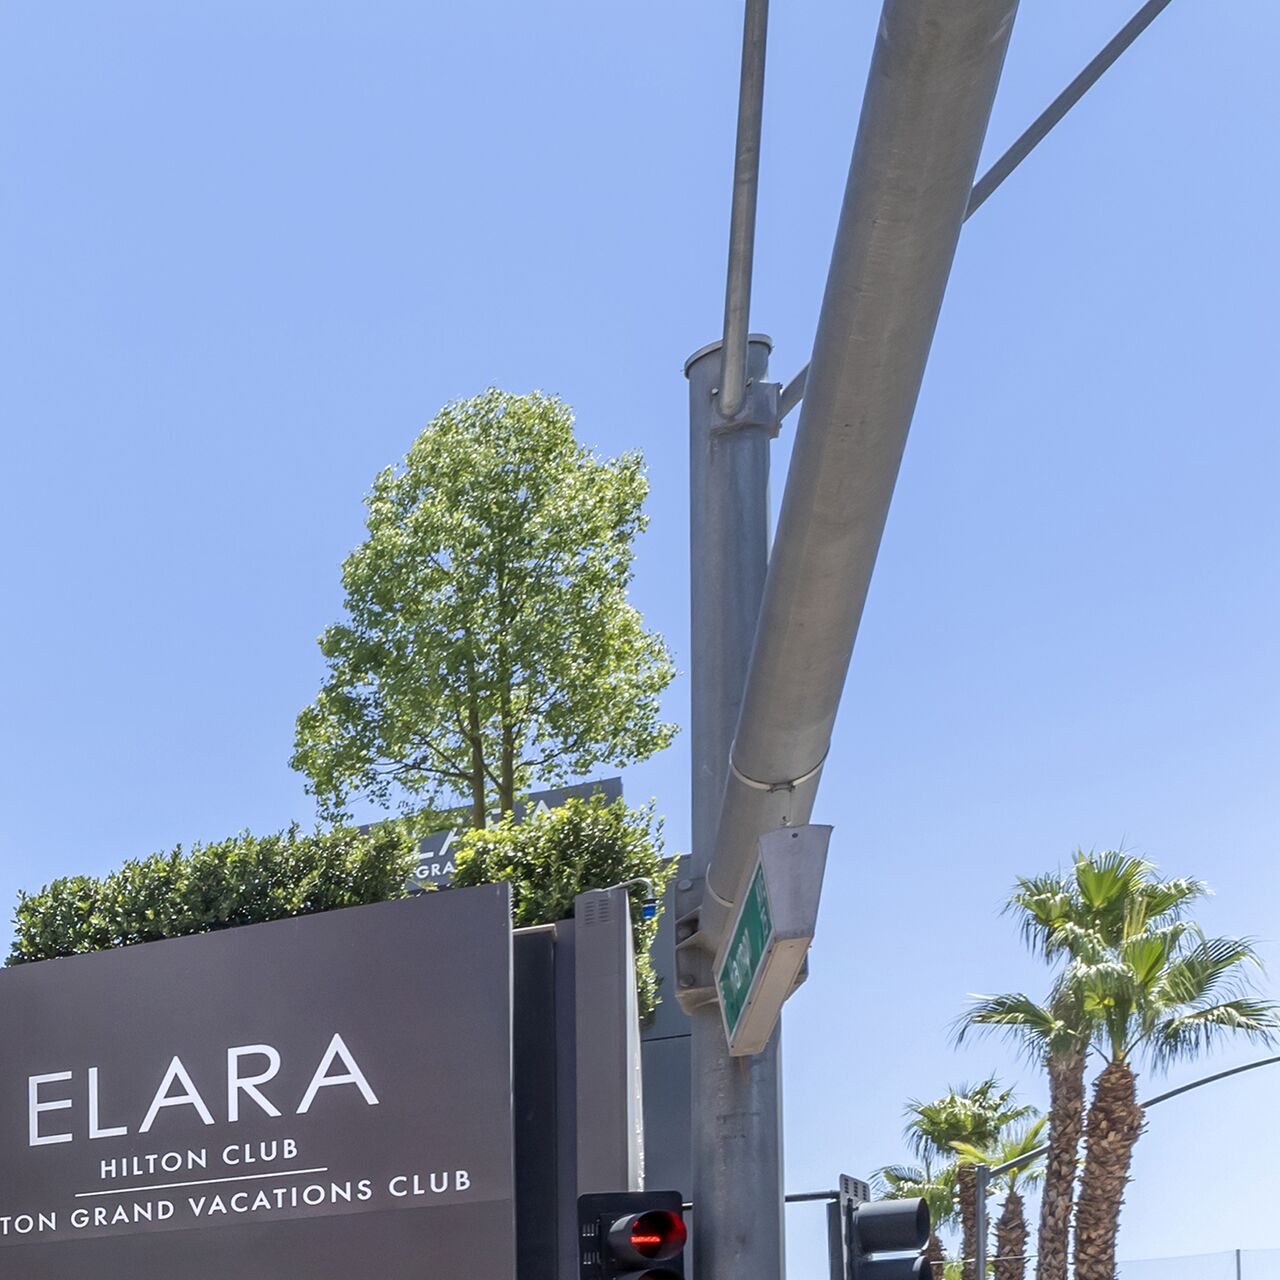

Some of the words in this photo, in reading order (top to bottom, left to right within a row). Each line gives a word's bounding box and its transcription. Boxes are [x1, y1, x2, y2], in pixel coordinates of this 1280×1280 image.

[415, 862, 455, 879] GRA
[29, 1033, 379, 1147] ELARA
[101, 1150, 207, 1179] HILTON
[223, 1140, 297, 1164] CLUB
[71, 1201, 173, 1227] GRAND
[189, 1179, 371, 1216] VACATIONS
[389, 1171, 470, 1196] CLUB
